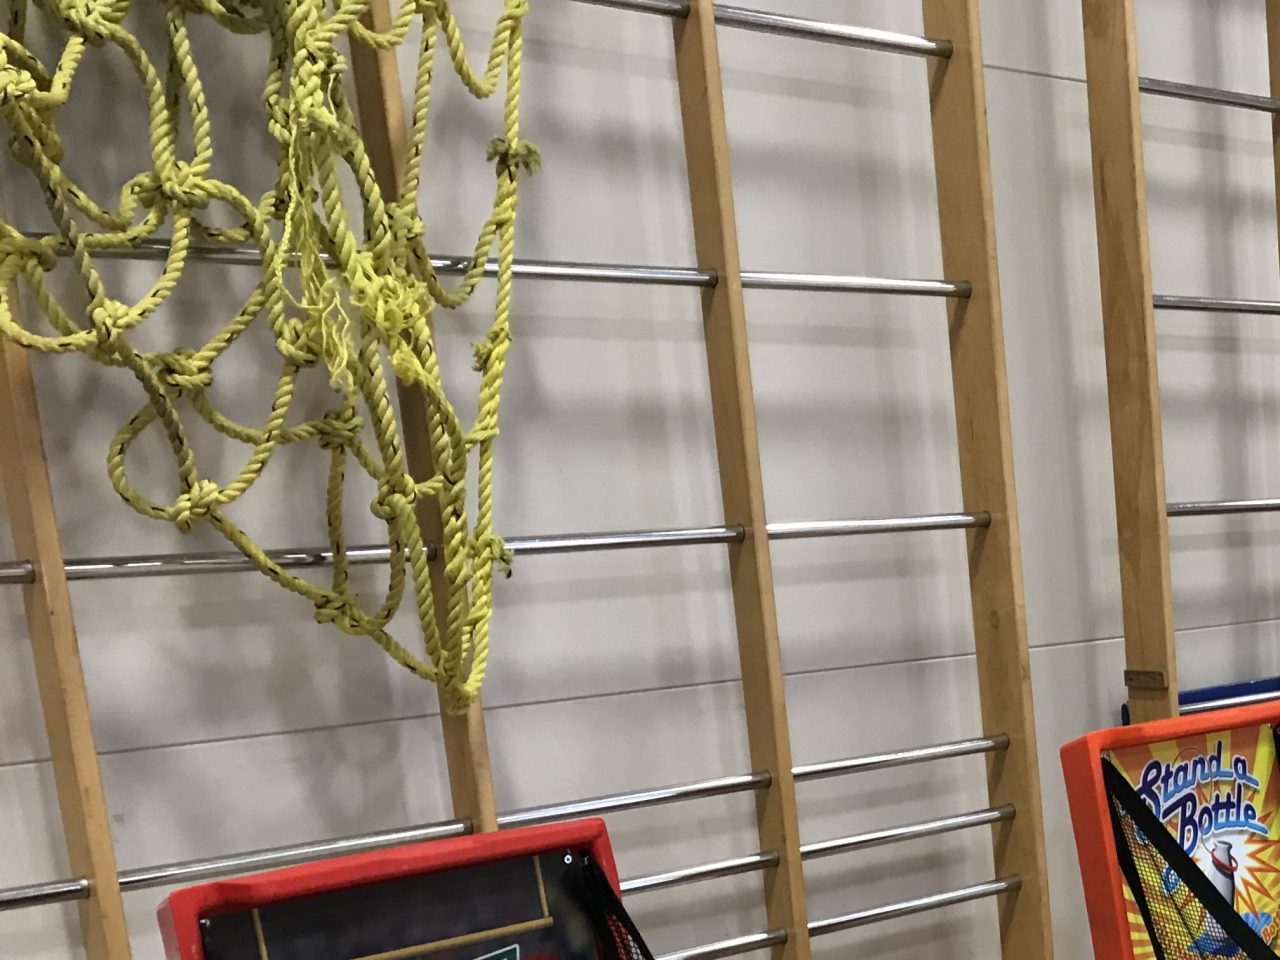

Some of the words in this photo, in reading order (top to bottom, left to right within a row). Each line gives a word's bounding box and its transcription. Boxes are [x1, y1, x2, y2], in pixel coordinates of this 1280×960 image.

[1135, 739, 1234, 820] Stand
[1232, 754, 1260, 790] a
[1161, 781, 1269, 857] Bottle
